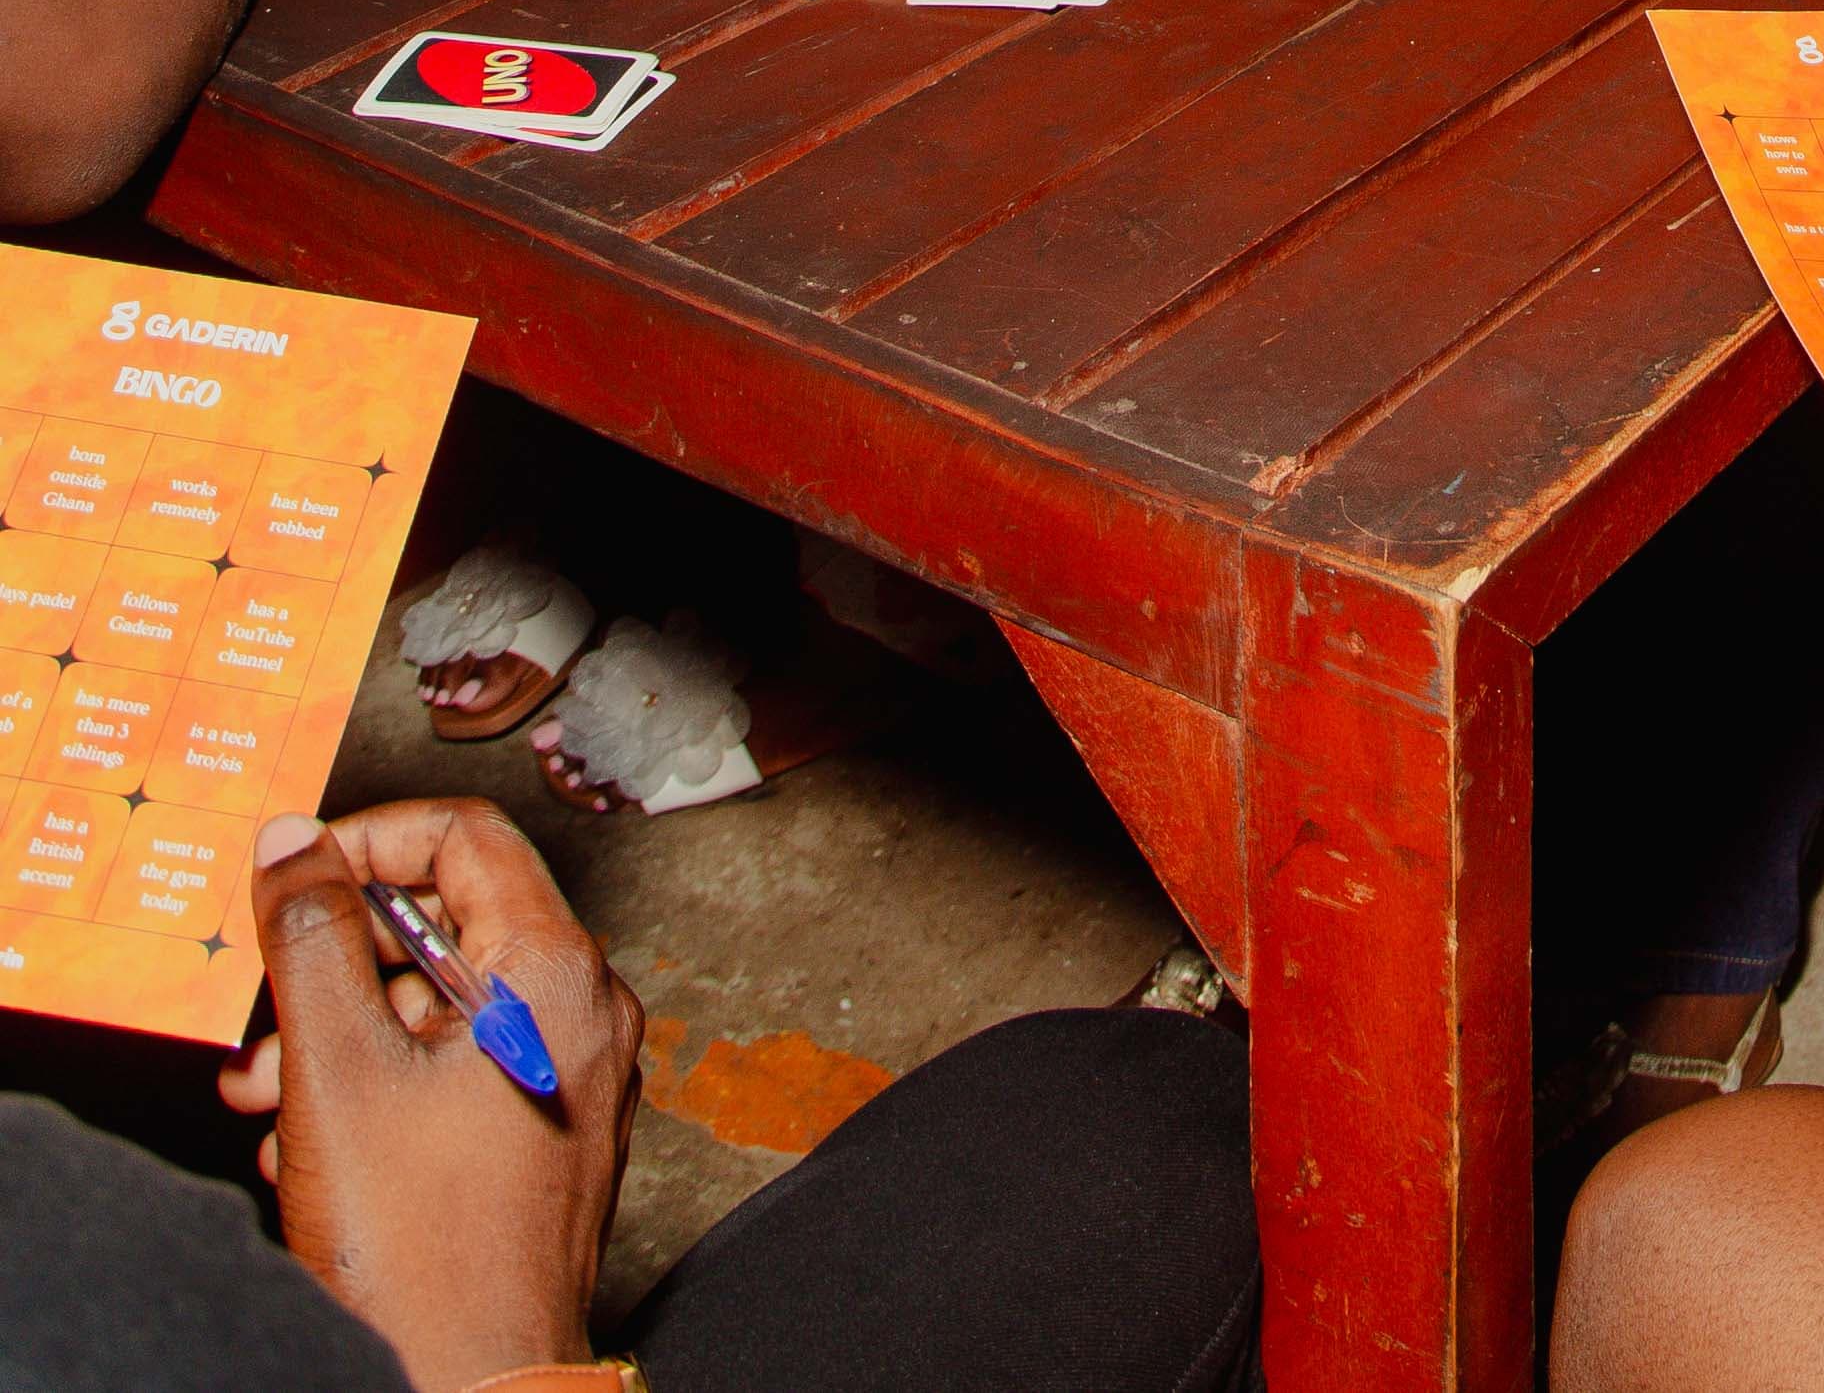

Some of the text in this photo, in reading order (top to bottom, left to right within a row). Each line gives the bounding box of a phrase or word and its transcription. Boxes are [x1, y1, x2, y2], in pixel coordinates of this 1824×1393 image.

[481, 48, 534, 105] UNO
[1759, 132, 1798, 145] knows
[1764, 148, 1805, 161] how to
[1776, 164, 1808, 176] swim
[1784, 222, 1807, 234] has
[1809, 225, 1817, 235] a
[144, 313, 289, 357] GADERIN
[113, 365, 222, 409] BINGO
[69, 445, 106, 465] born
[50, 470, 107, 491] outside
[170, 477, 218, 497] works
[43, 491, 95, 514] Ghana
[151, 499, 221, 526] remotely
[269, 493, 340, 519] has been
[268, 519, 326, 541] robbed
[30, 591, 76, 611] padel
[121, 590, 180, 615] follows
[245, 599, 289, 621] has a
[108, 615, 174, 641] Gaderin
[224, 621, 296, 649] YouTube
[217, 648, 284, 673] channel
[1, 690, 33, 710] of a
[74, 689, 151, 716] has more
[75, 716, 130, 740] than 3
[189, 722, 258, 750] is a tech
[61, 742, 126, 770] siblings
[185, 748, 245, 774] bro/sis
[44, 811, 90, 836] has a
[29, 837, 85, 863] British
[151, 838, 216, 862] went to
[19, 867, 76, 890] accent
[139, 862, 208, 891] the gym
[139, 891, 189, 917] today
